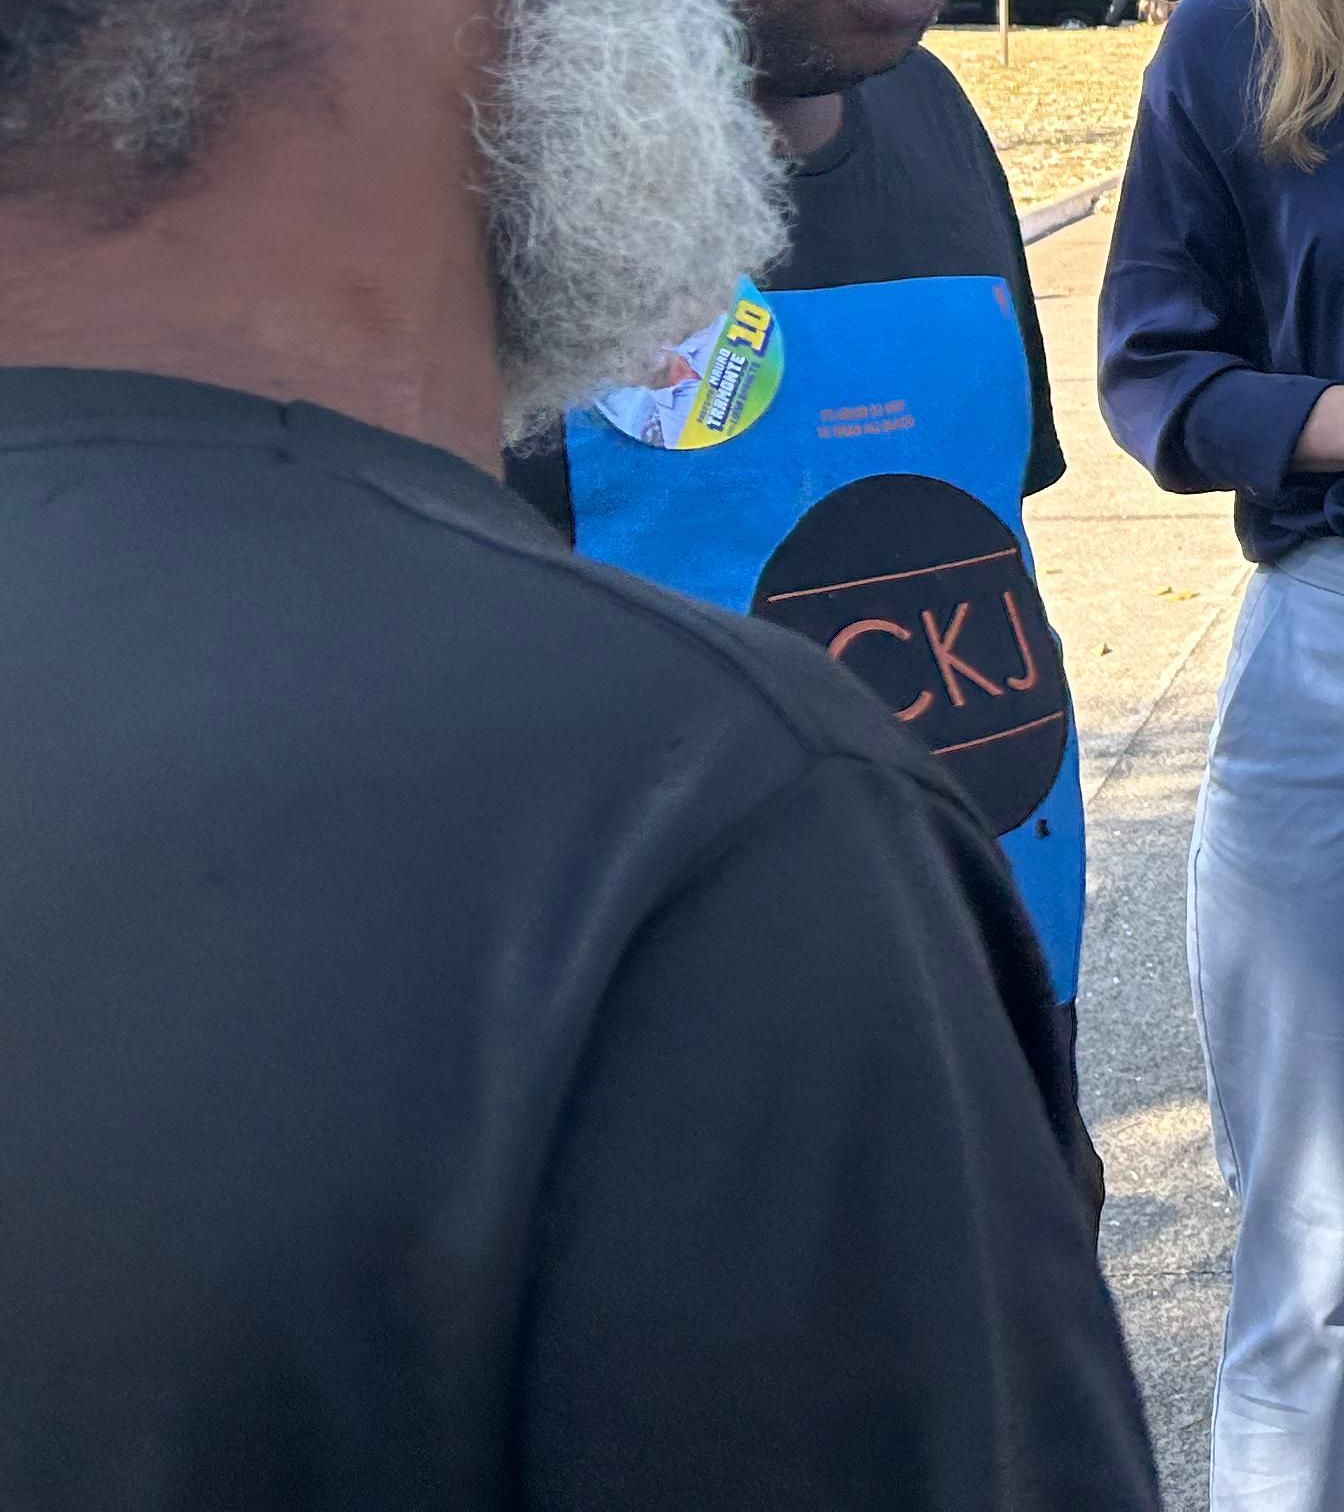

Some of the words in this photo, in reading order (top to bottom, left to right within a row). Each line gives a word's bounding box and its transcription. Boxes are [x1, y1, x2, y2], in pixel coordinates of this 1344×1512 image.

[726, 299, 775, 357] 10
[706, 352, 748, 432] TRAMONTE
[707, 347, 732, 389] MAURO
[826, 591, 1039, 722] CKJ
